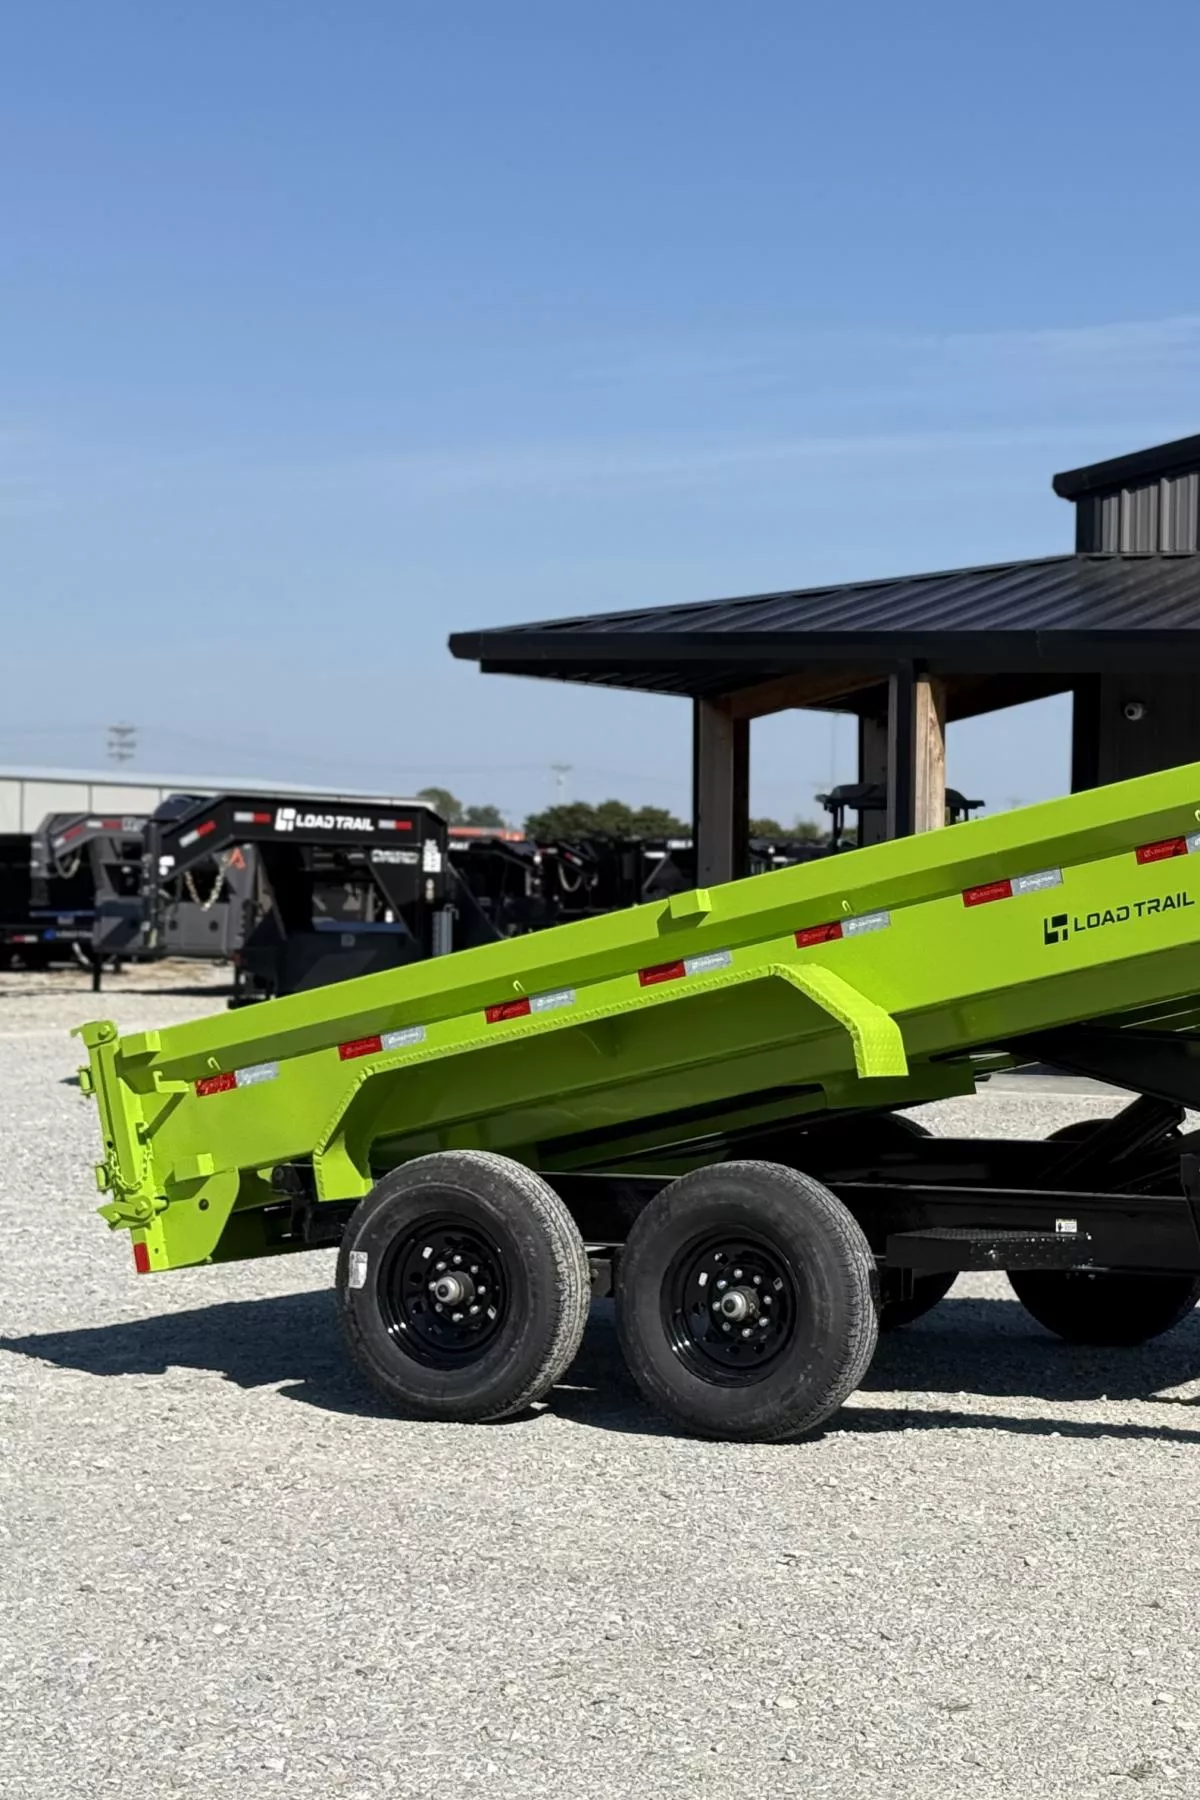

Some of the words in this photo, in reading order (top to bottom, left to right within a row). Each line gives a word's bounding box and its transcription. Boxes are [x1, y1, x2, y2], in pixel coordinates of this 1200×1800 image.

[295, 814, 334, 829] LOAD
[336, 816, 374, 831] TRAIL
[1074, 906, 1130, 932] LOAD
[1133, 892, 1195, 917] TRAIL
